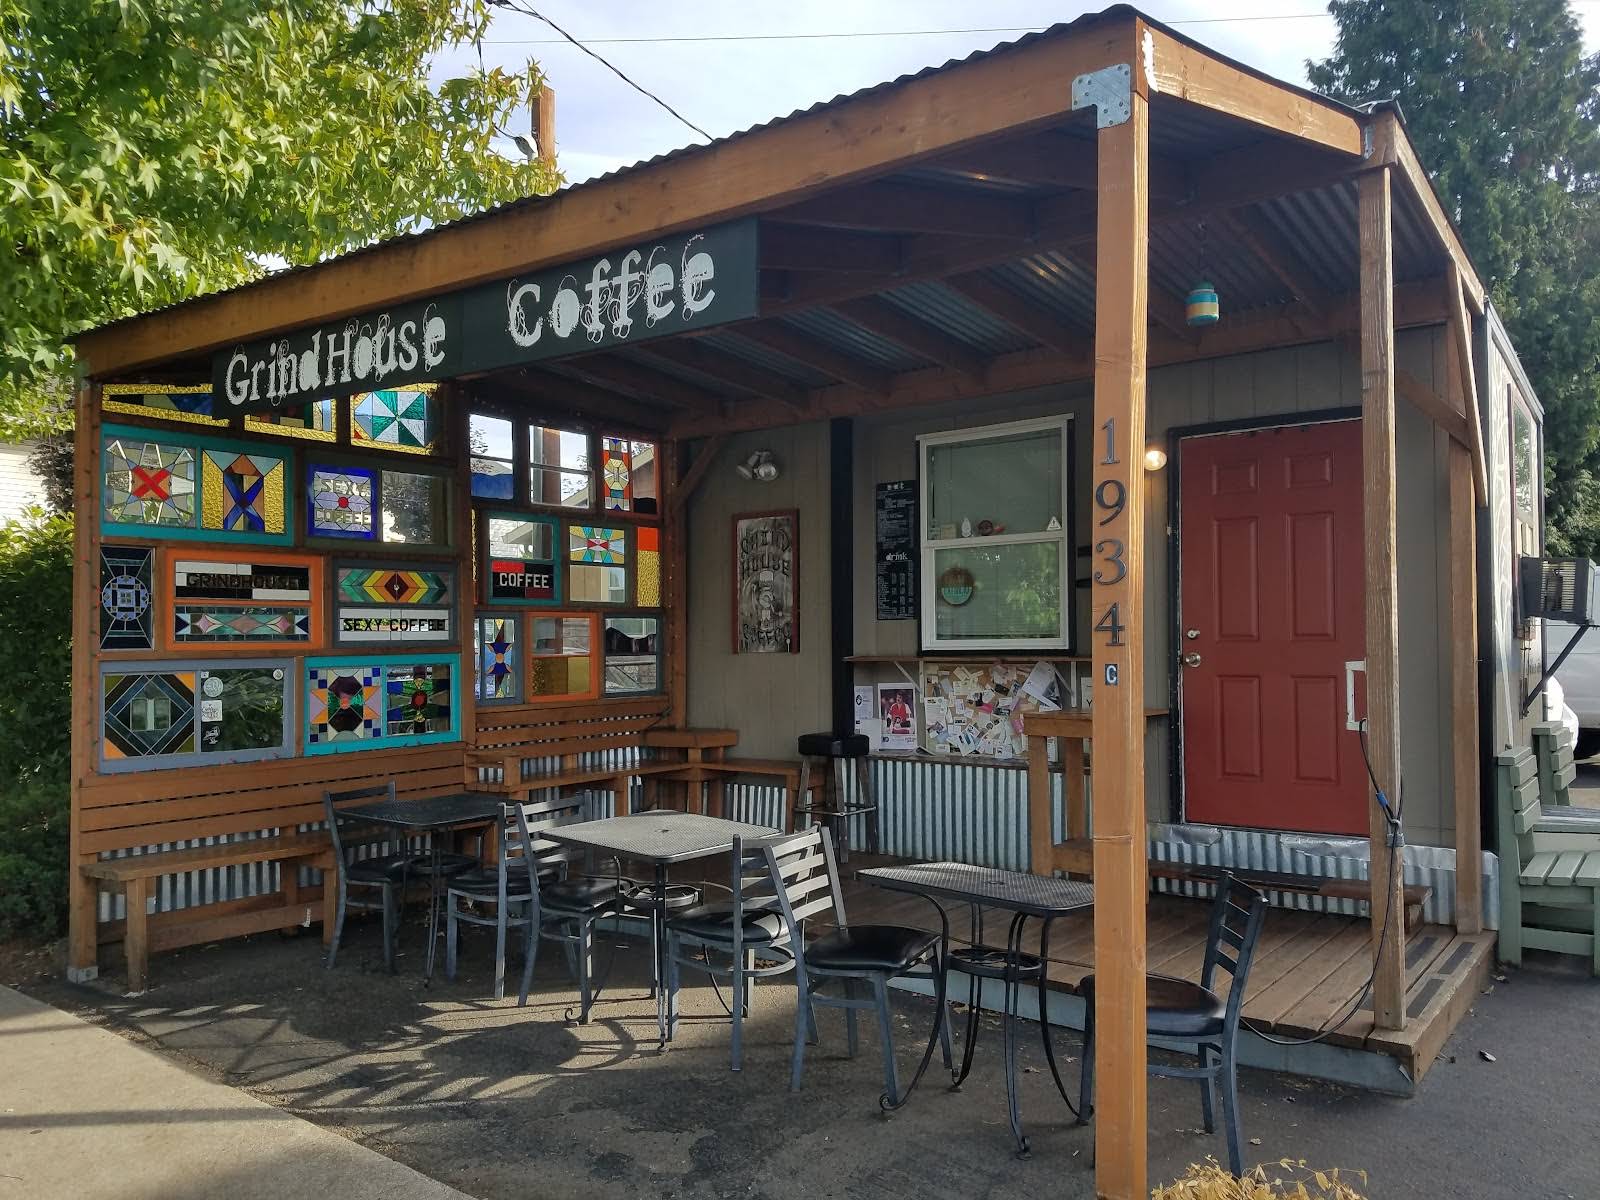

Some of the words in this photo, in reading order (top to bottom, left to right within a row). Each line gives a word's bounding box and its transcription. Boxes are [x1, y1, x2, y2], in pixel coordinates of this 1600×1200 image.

[505, 234, 716, 348] Coffee
[1094, 416, 1127, 647] 1934
[499, 572, 550, 589] COFFEE
[343, 617, 383, 632] SEXY
[389, 618, 446, 632] COFFEE
[1106, 664, 1117, 684] C
